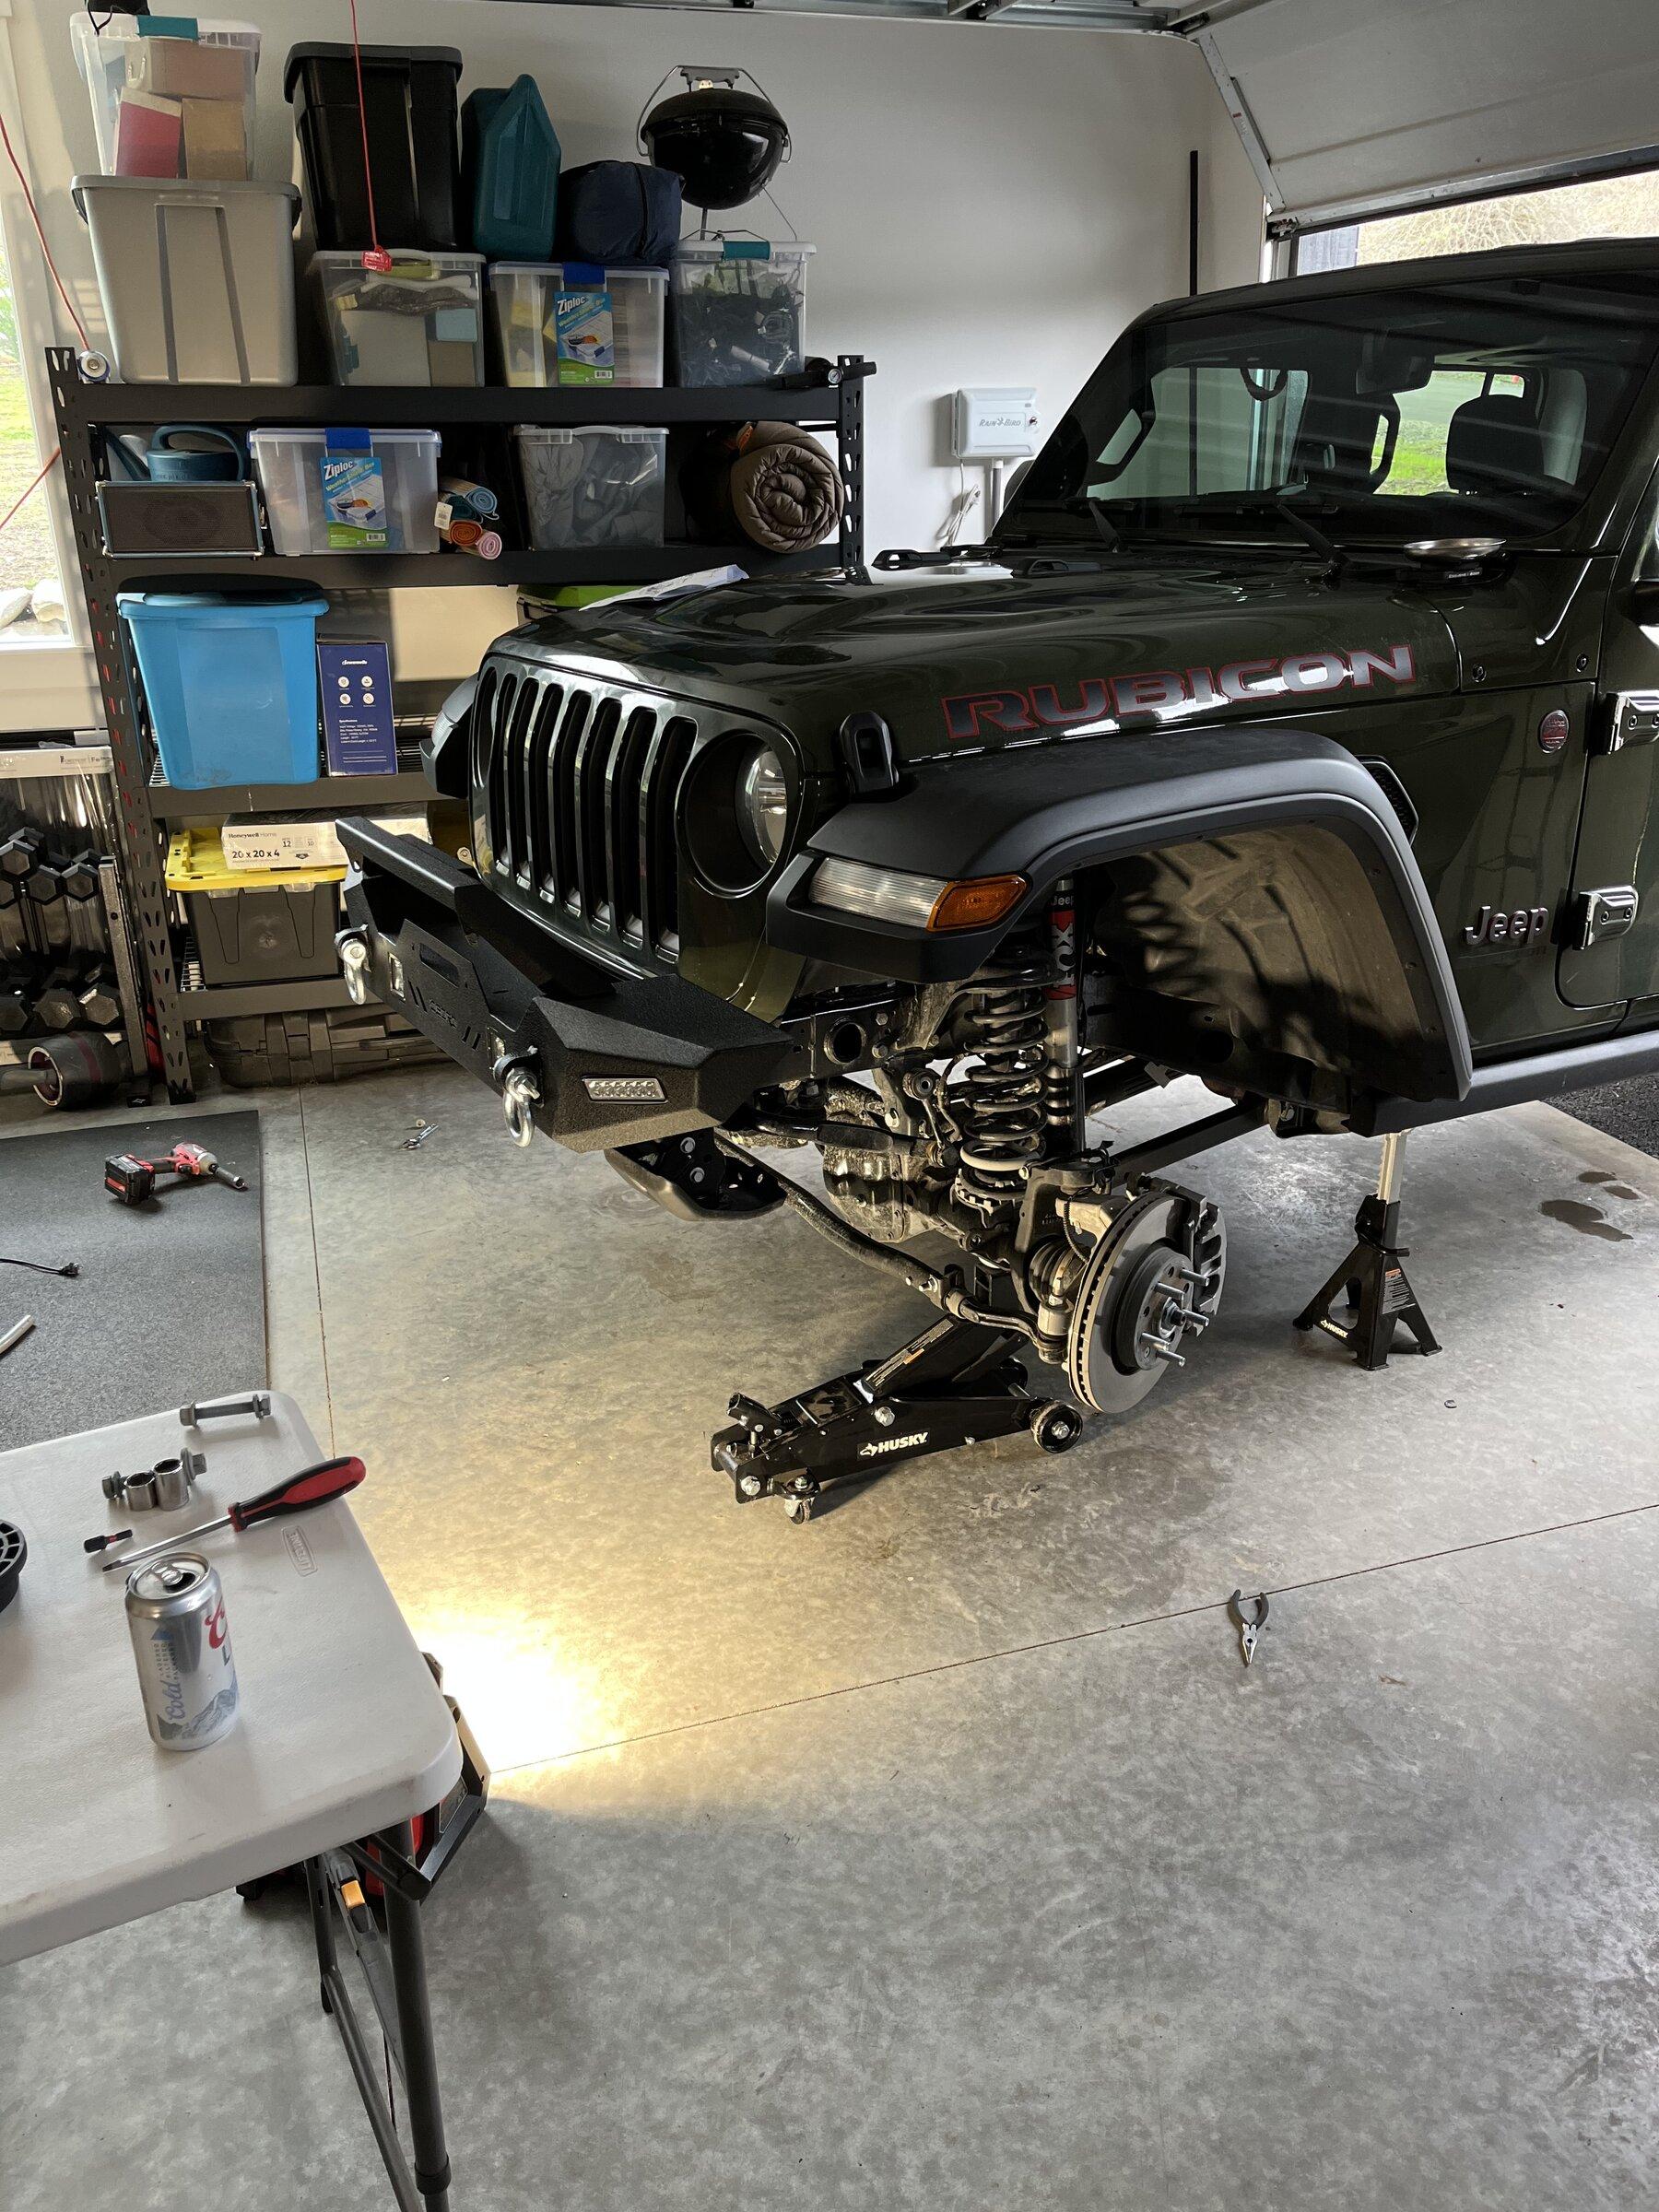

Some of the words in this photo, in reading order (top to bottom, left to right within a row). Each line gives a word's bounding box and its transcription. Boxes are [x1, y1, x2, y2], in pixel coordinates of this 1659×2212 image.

[557, 296, 586, 315] Ziploc
[324, 461, 354, 481] Ziploc
[941, 644, 1416, 739] RUBICON
[232, 850, 244, 859] 20
[253, 849, 265, 858] 20
[274, 849, 280, 857] 4
[282, 840, 291, 848] 12
[1464, 905, 1548, 946] Jeep
[877, 1431, 929, 1453] HUSKY
[160, 1679, 186, 1721] Cold
